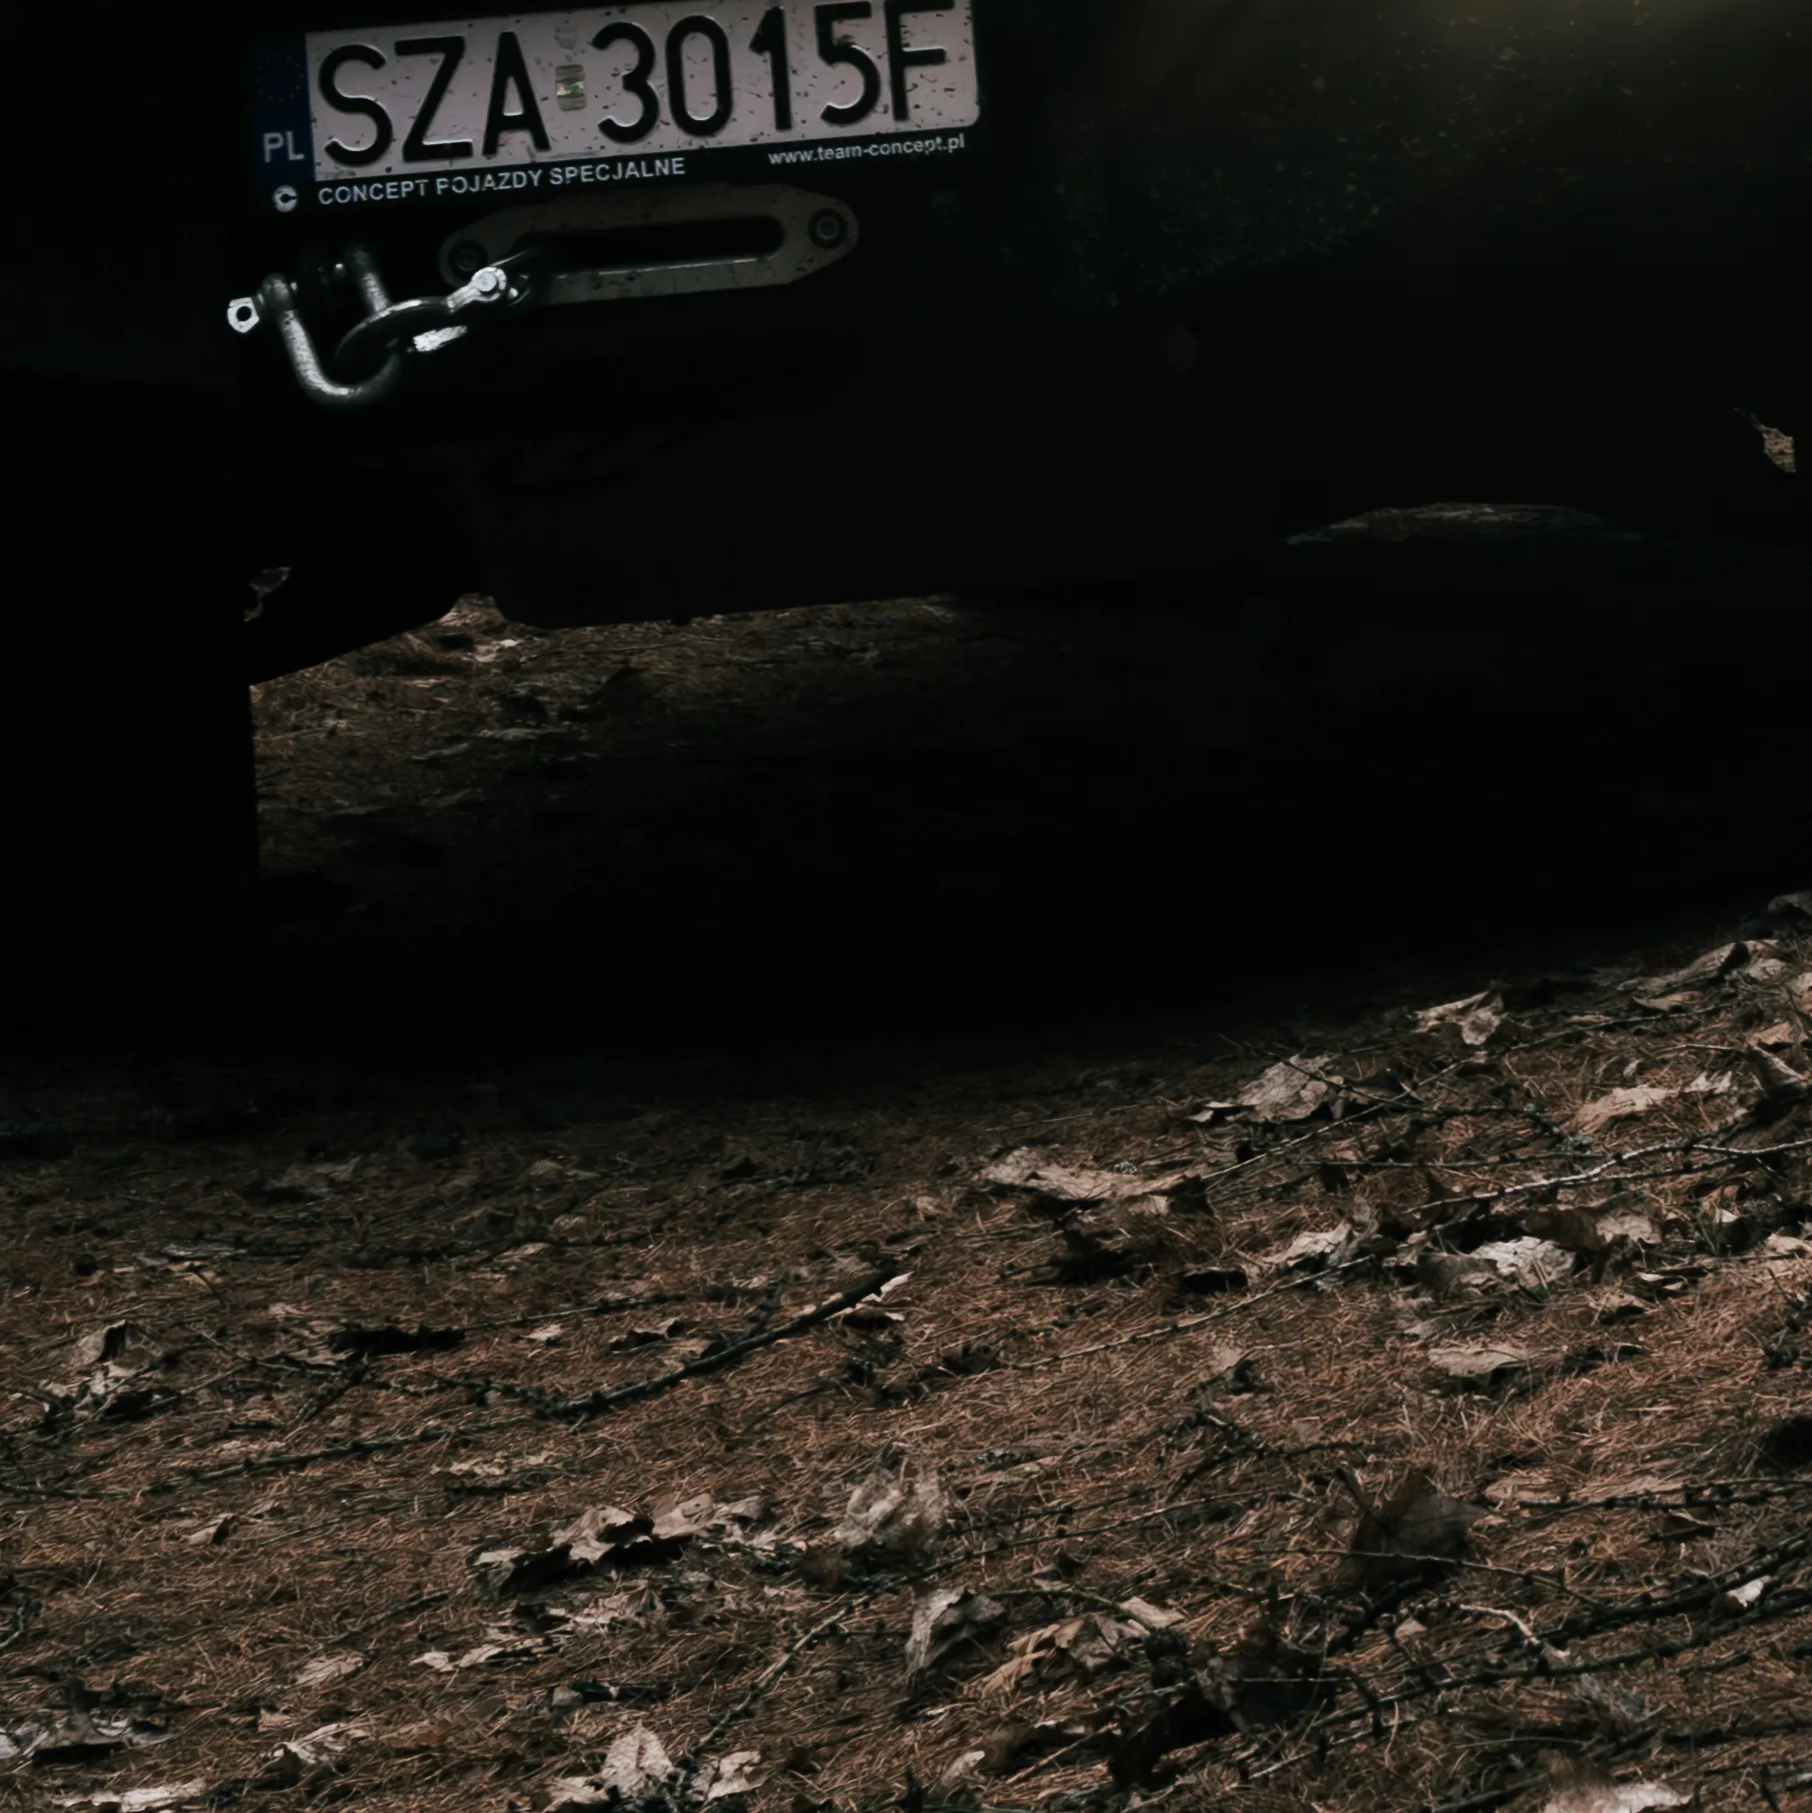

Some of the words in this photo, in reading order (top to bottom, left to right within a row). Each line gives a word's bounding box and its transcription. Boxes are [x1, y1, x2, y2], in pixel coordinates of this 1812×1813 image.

[317, 31, 551, 168] SZA
[263, 131, 305, 163] PL
[768, 133, 965, 165] www.team-concept.pl
[318, 179, 429, 205] CONCEPT
[436, 167, 543, 195] POJAZDY
[549, 157, 687, 185] SPECJALNE
